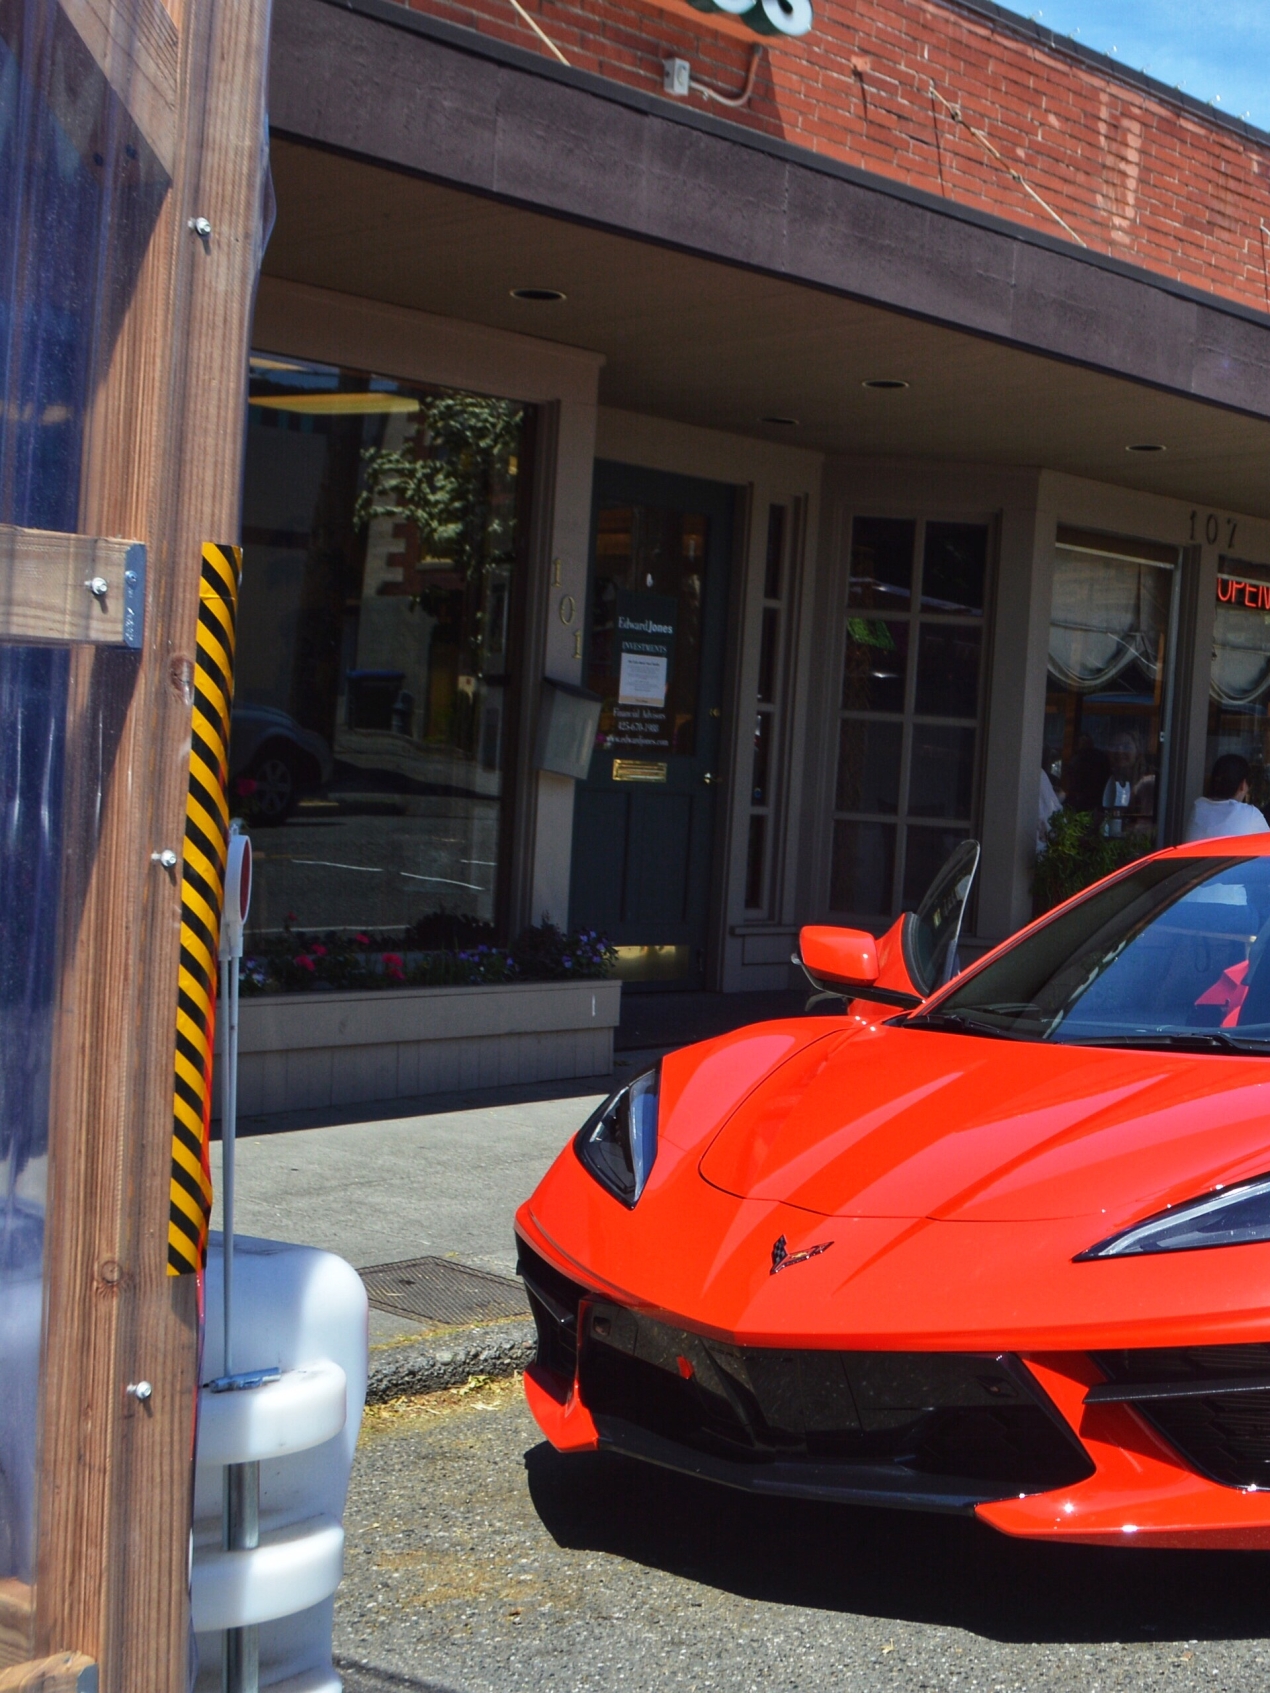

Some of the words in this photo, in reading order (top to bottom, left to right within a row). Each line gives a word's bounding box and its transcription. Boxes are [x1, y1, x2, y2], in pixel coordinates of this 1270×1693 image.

[1189, 510, 1238, 549] 107
[551, 557, 582, 659] 101
[622, 641, 668, 654] INVESTMENTS
